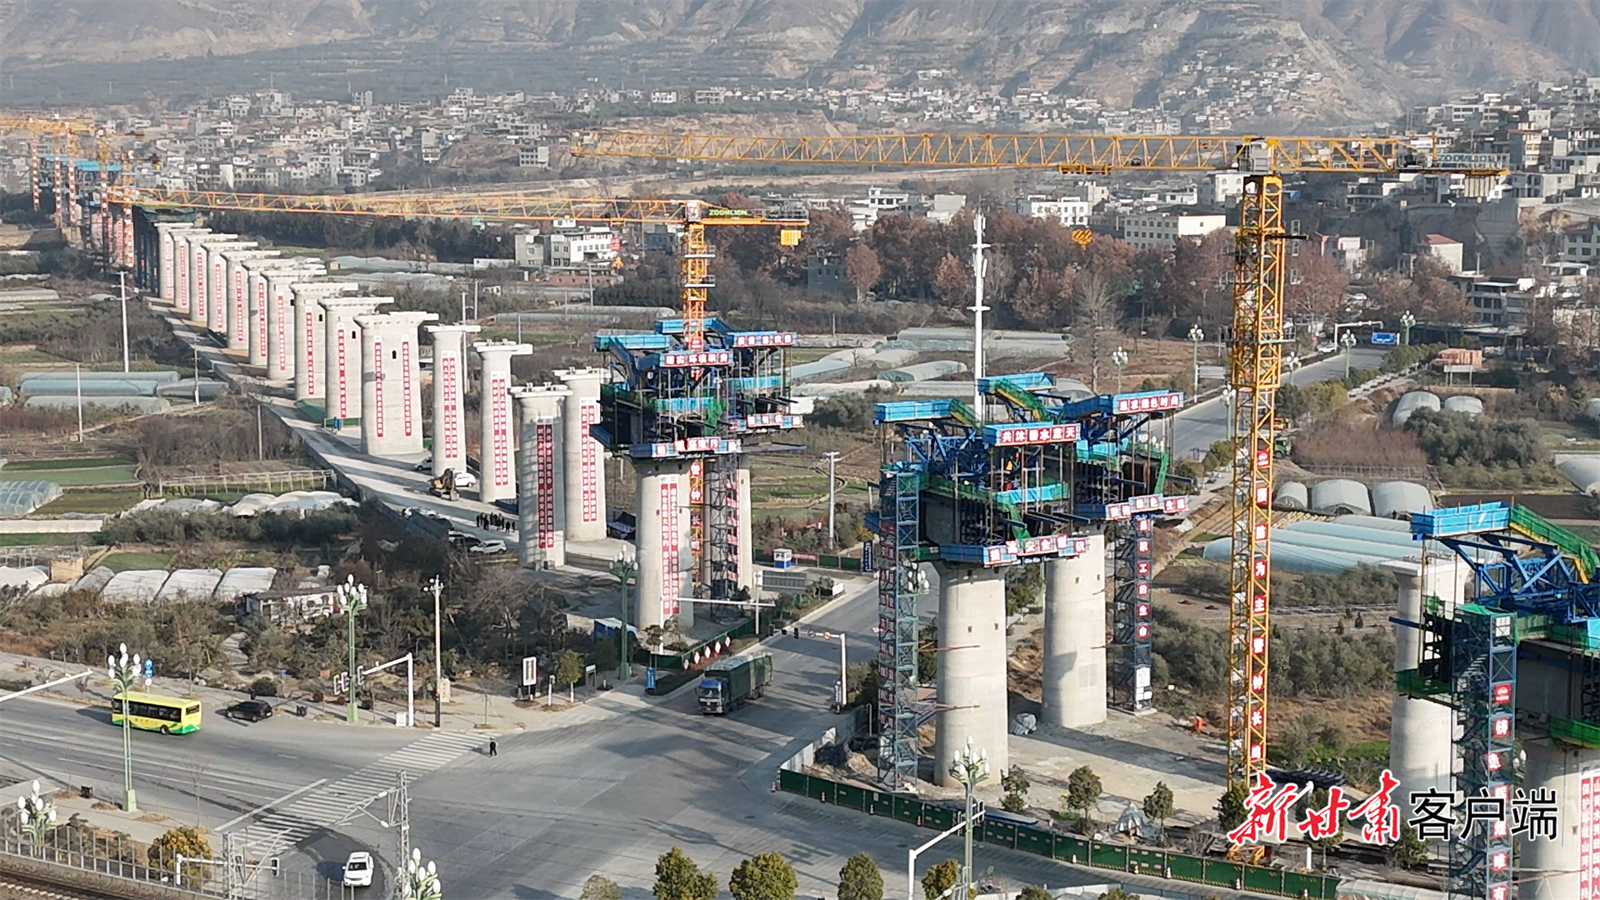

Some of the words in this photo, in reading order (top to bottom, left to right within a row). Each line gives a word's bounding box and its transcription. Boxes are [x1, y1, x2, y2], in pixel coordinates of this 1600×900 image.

[709, 208, 748, 217] ZOOMLION
[1001, 425, 1076, 444] 共沐碧水蓝天
